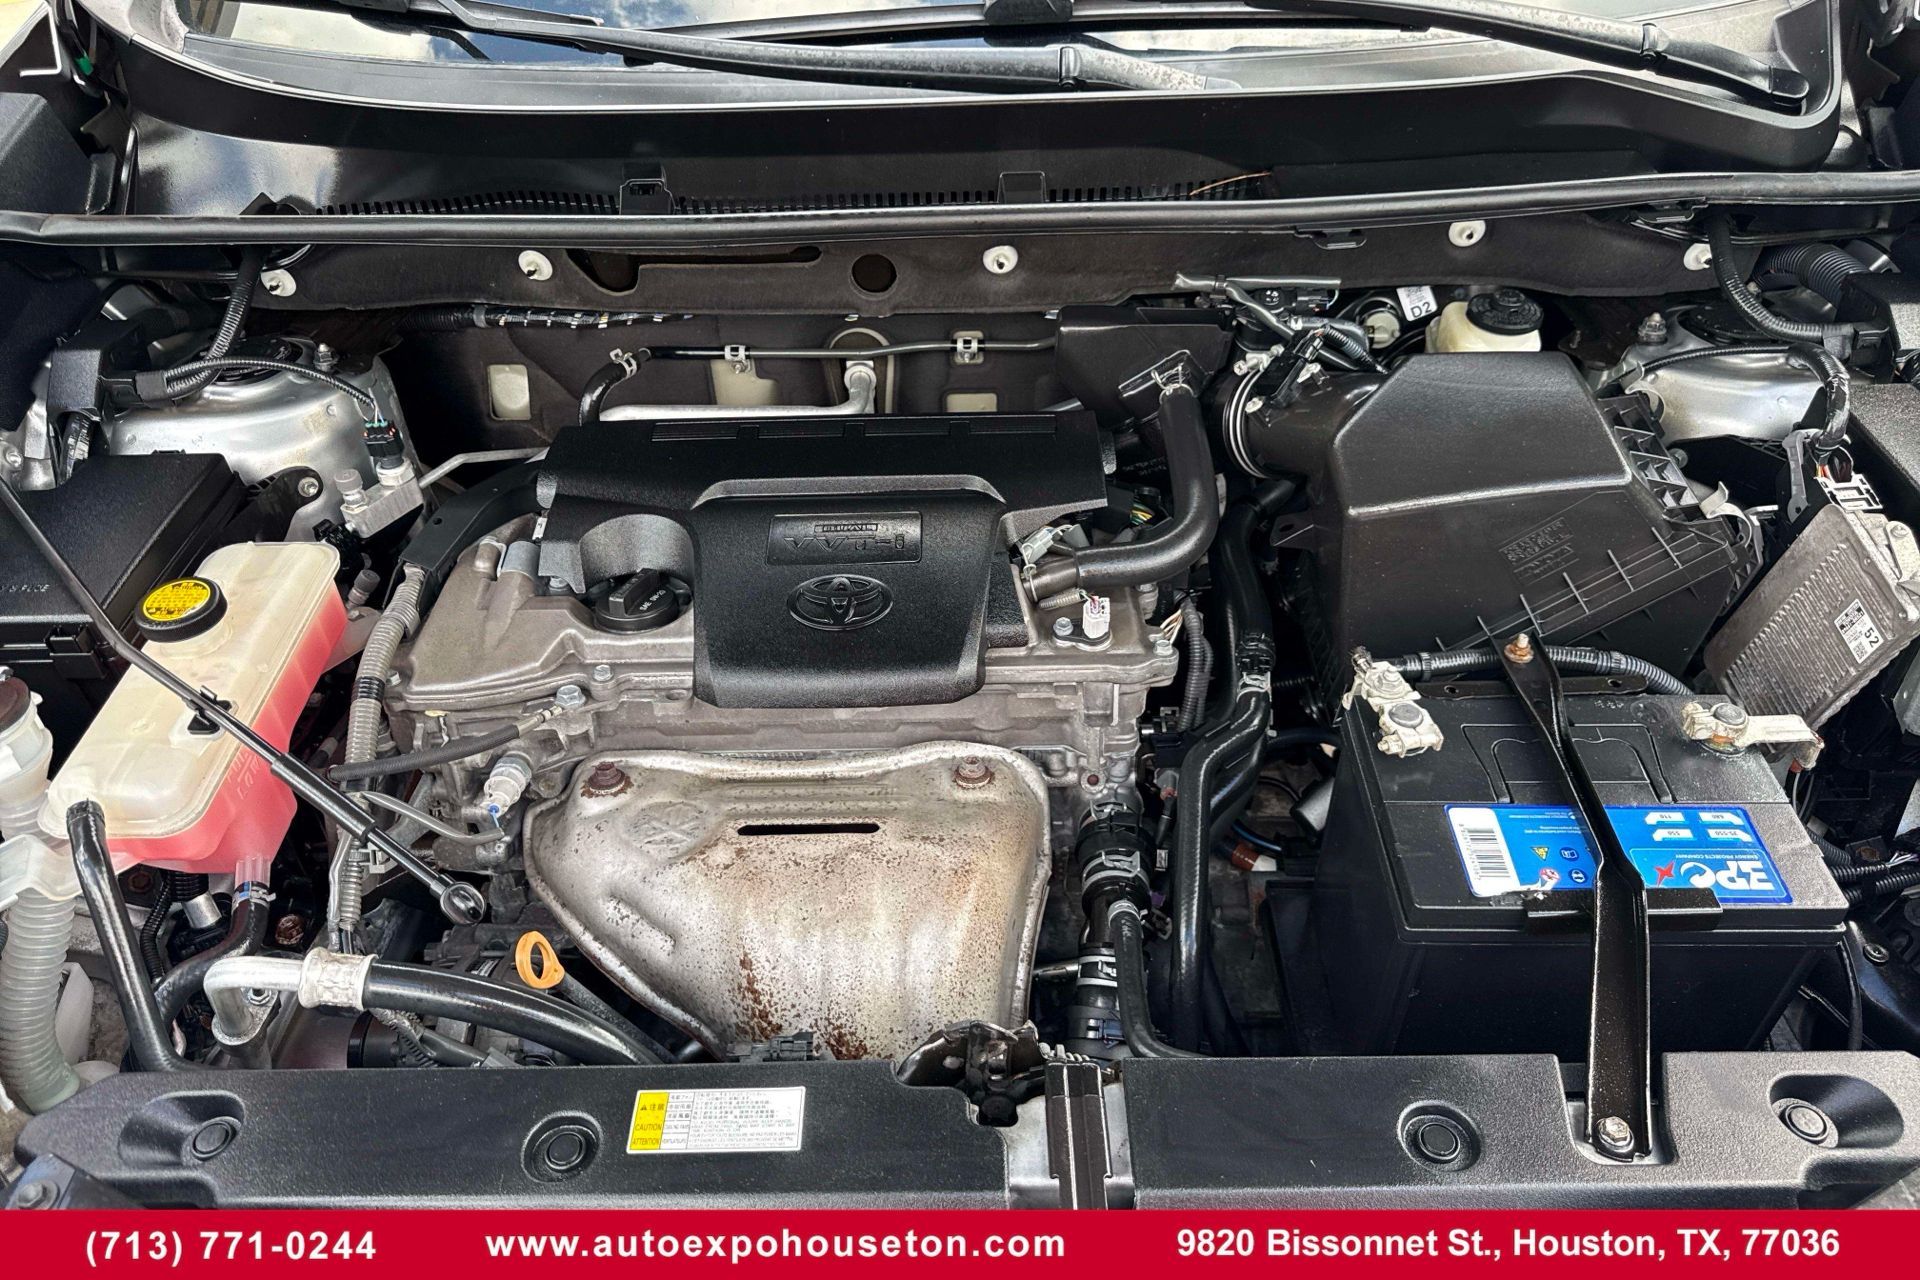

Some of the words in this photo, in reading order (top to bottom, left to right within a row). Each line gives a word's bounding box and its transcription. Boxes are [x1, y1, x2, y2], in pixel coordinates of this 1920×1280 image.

[1410, 301, 1432, 318] D2
[1864, 627, 1880, 648] 52
[634, 1123, 663, 1132] CAUTION
[632, 1137, 660, 1146] ATTENTION
